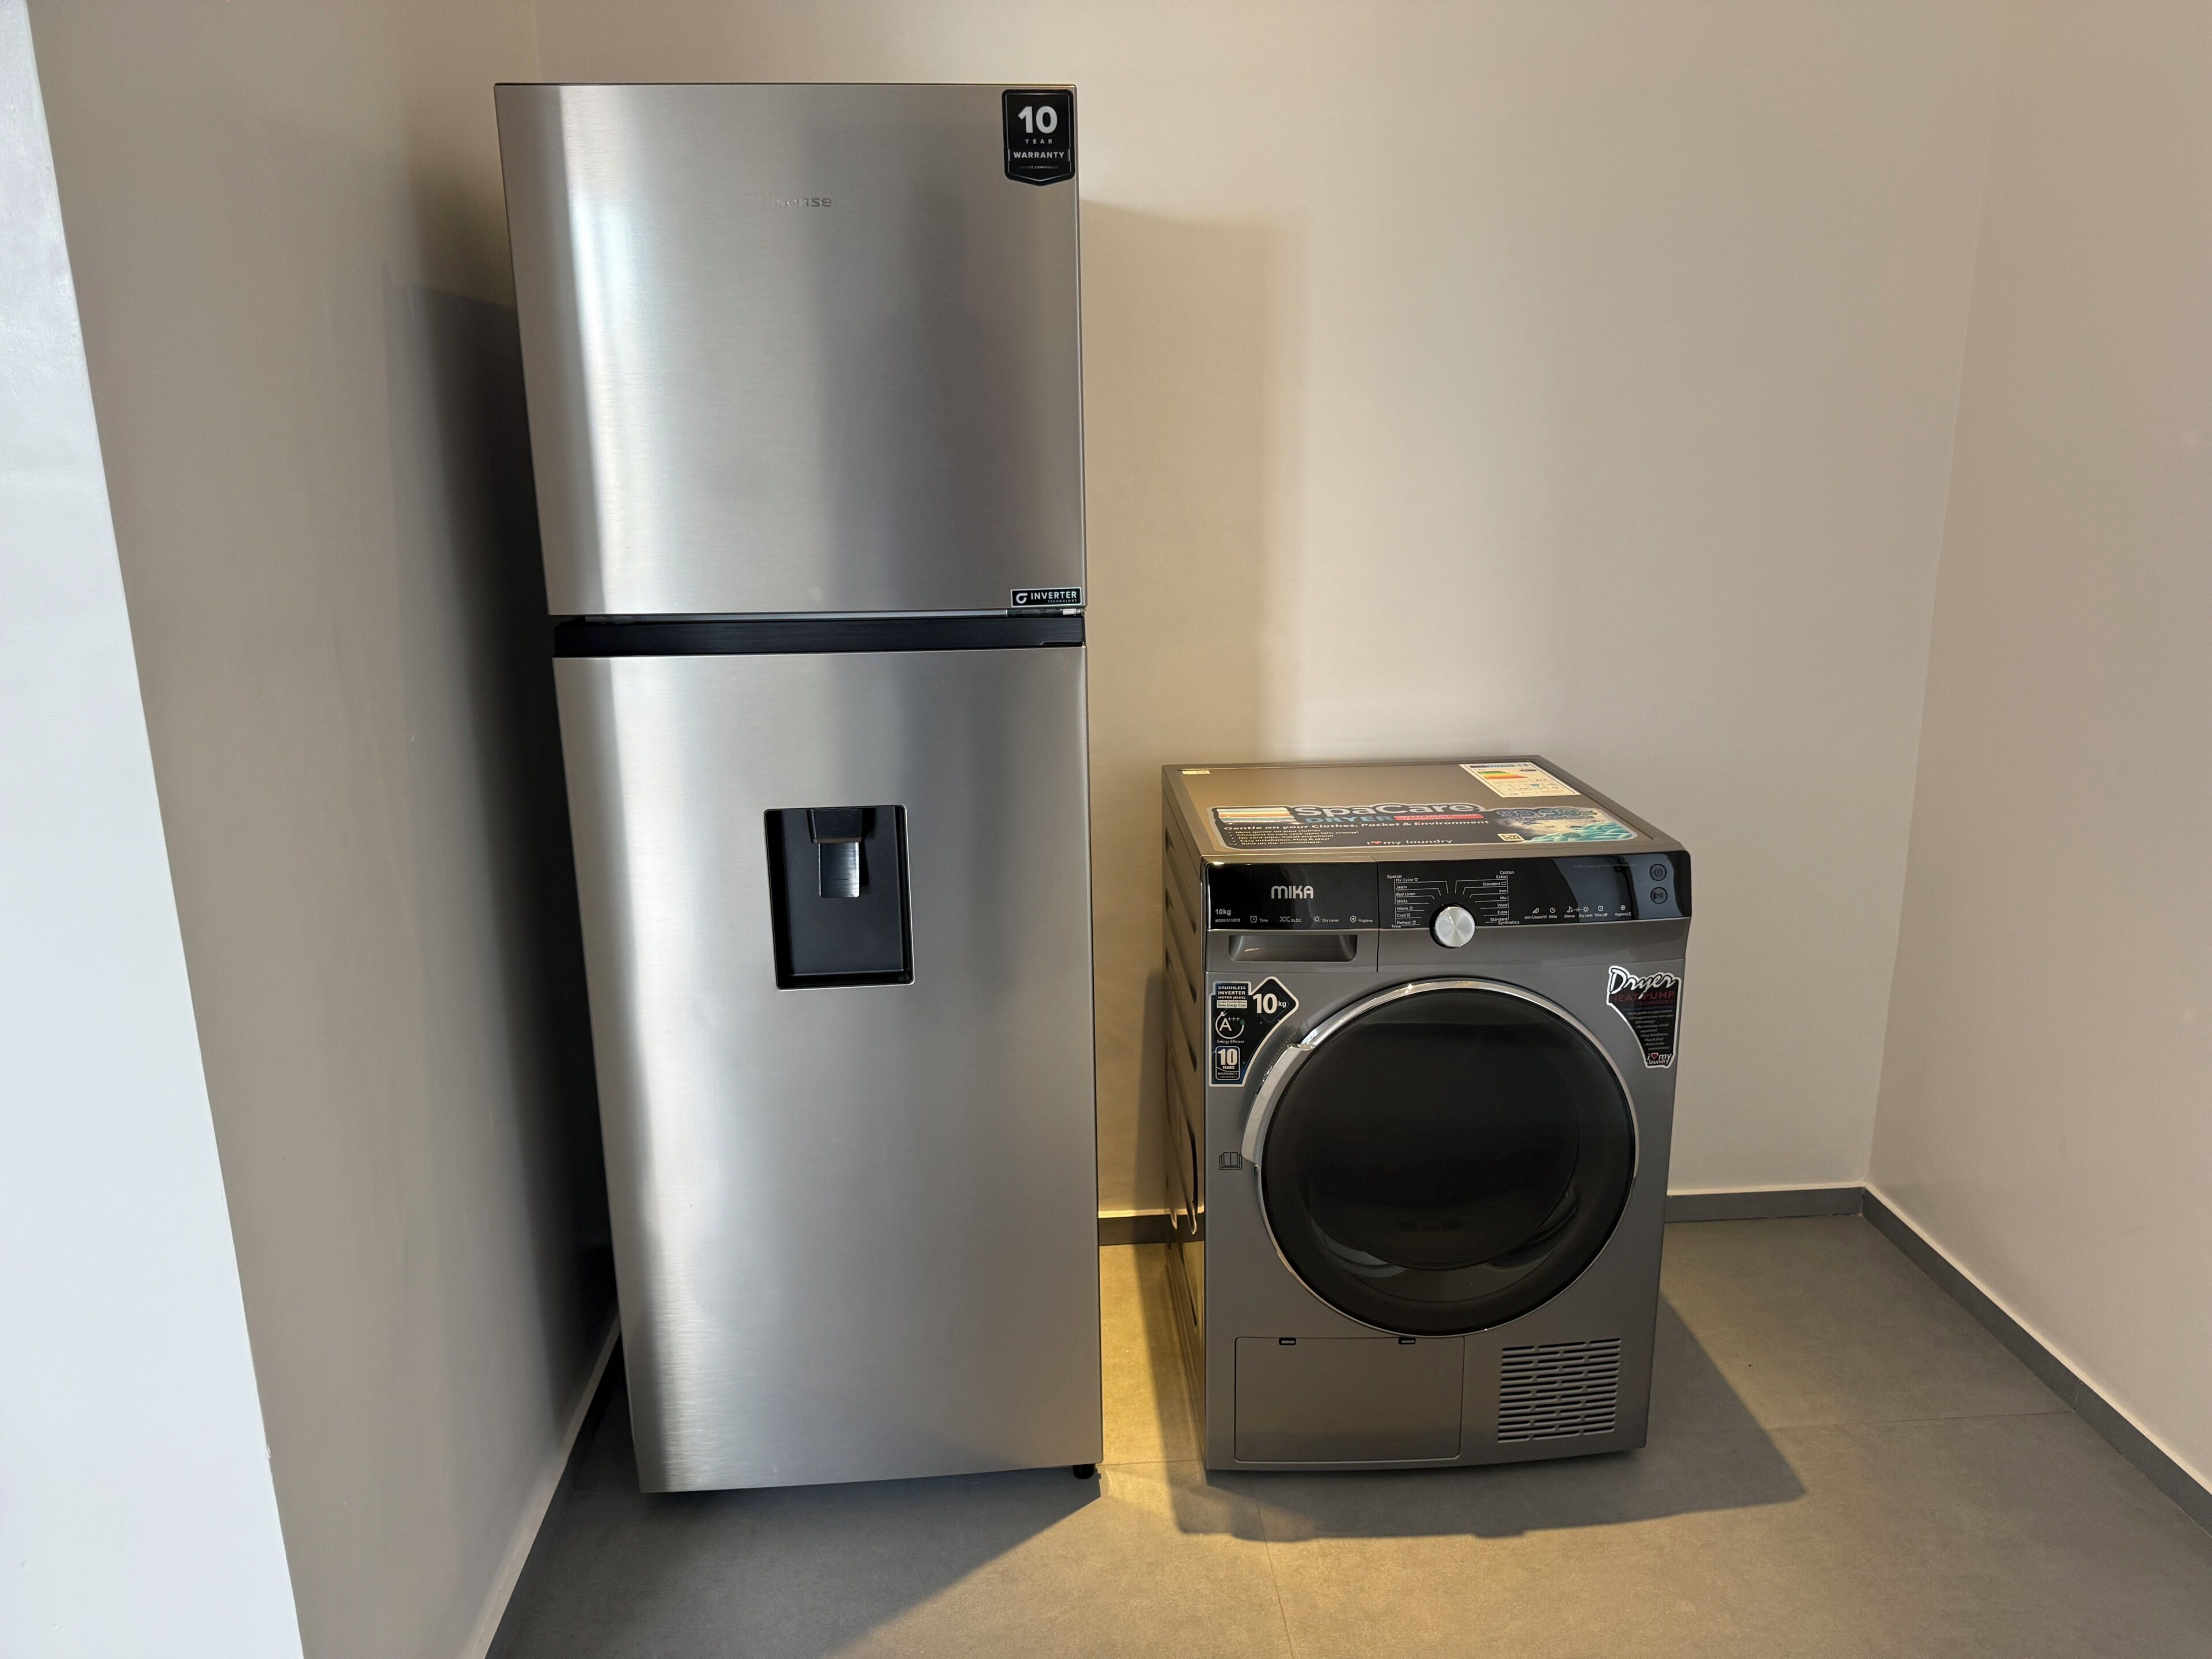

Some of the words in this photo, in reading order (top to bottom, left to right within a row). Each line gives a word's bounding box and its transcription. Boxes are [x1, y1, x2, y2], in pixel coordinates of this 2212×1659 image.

[1018, 105, 1058, 134] 10
[1031, 591, 1077, 600] INVERTER
[1294, 804, 1475, 817] SpaCare
[1305, 815, 1395, 823] DRYER
[1271, 885, 1314, 899] MIKA
[1610, 968, 1677, 1000] Dryer
[1610, 993, 1639, 1002] HEAT
[1643, 990, 1675, 999] PUMP
[1218, 1048, 1238, 1066] 10
